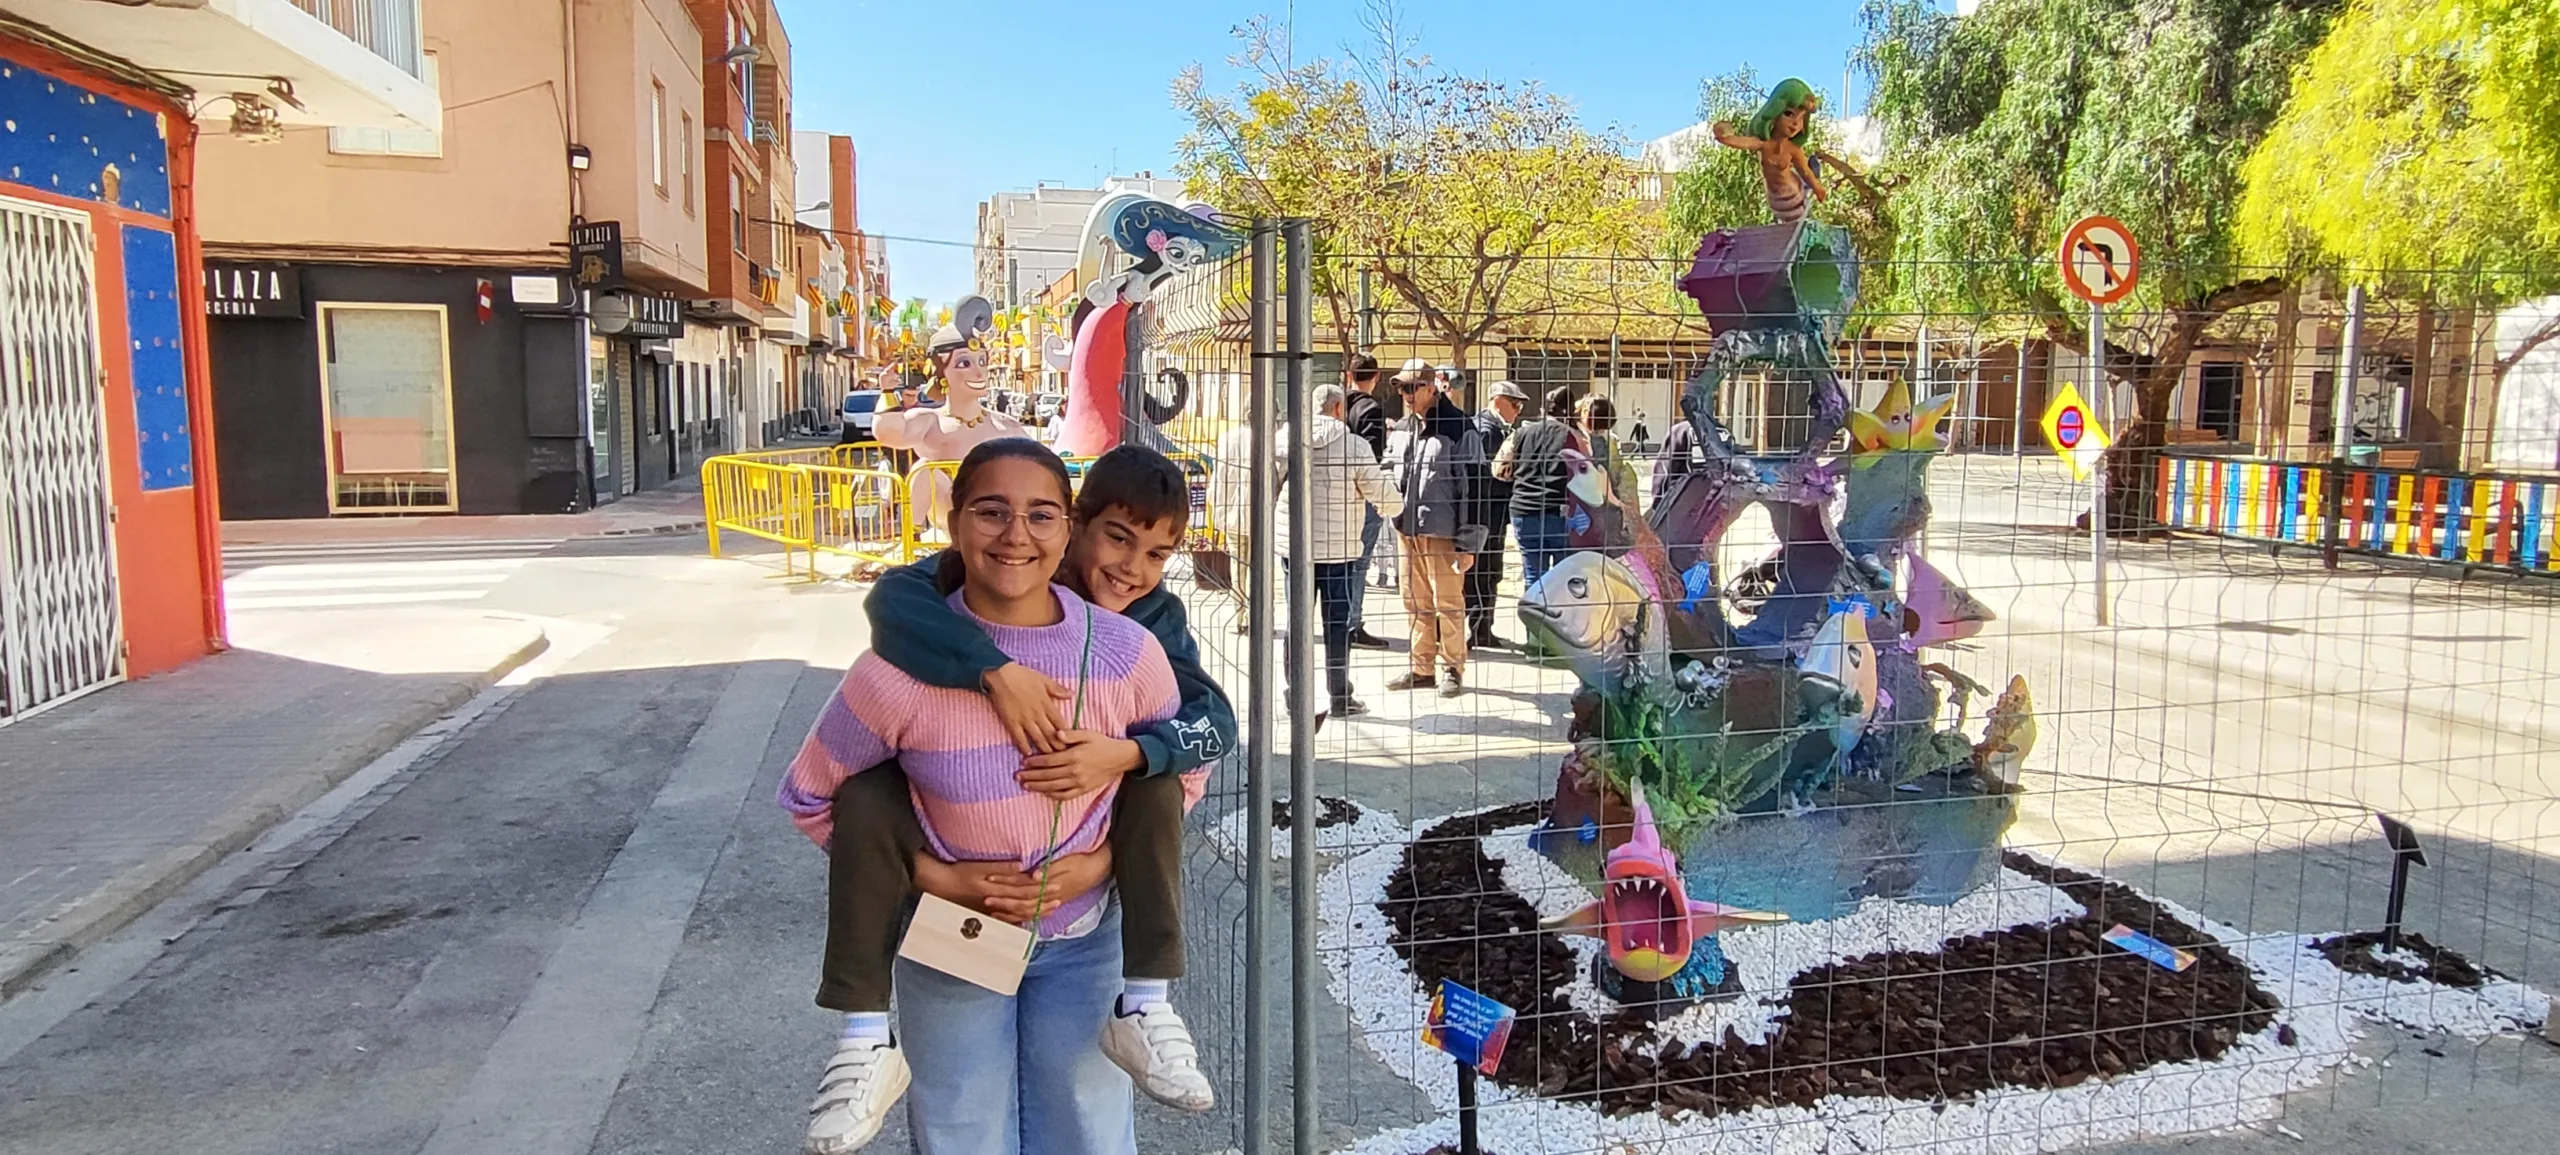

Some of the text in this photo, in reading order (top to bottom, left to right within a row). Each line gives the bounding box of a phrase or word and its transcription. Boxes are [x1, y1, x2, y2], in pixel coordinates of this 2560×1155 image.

[571, 226, 611, 246] LA PLAZA
[621, 294, 679, 323] A PLAZA
